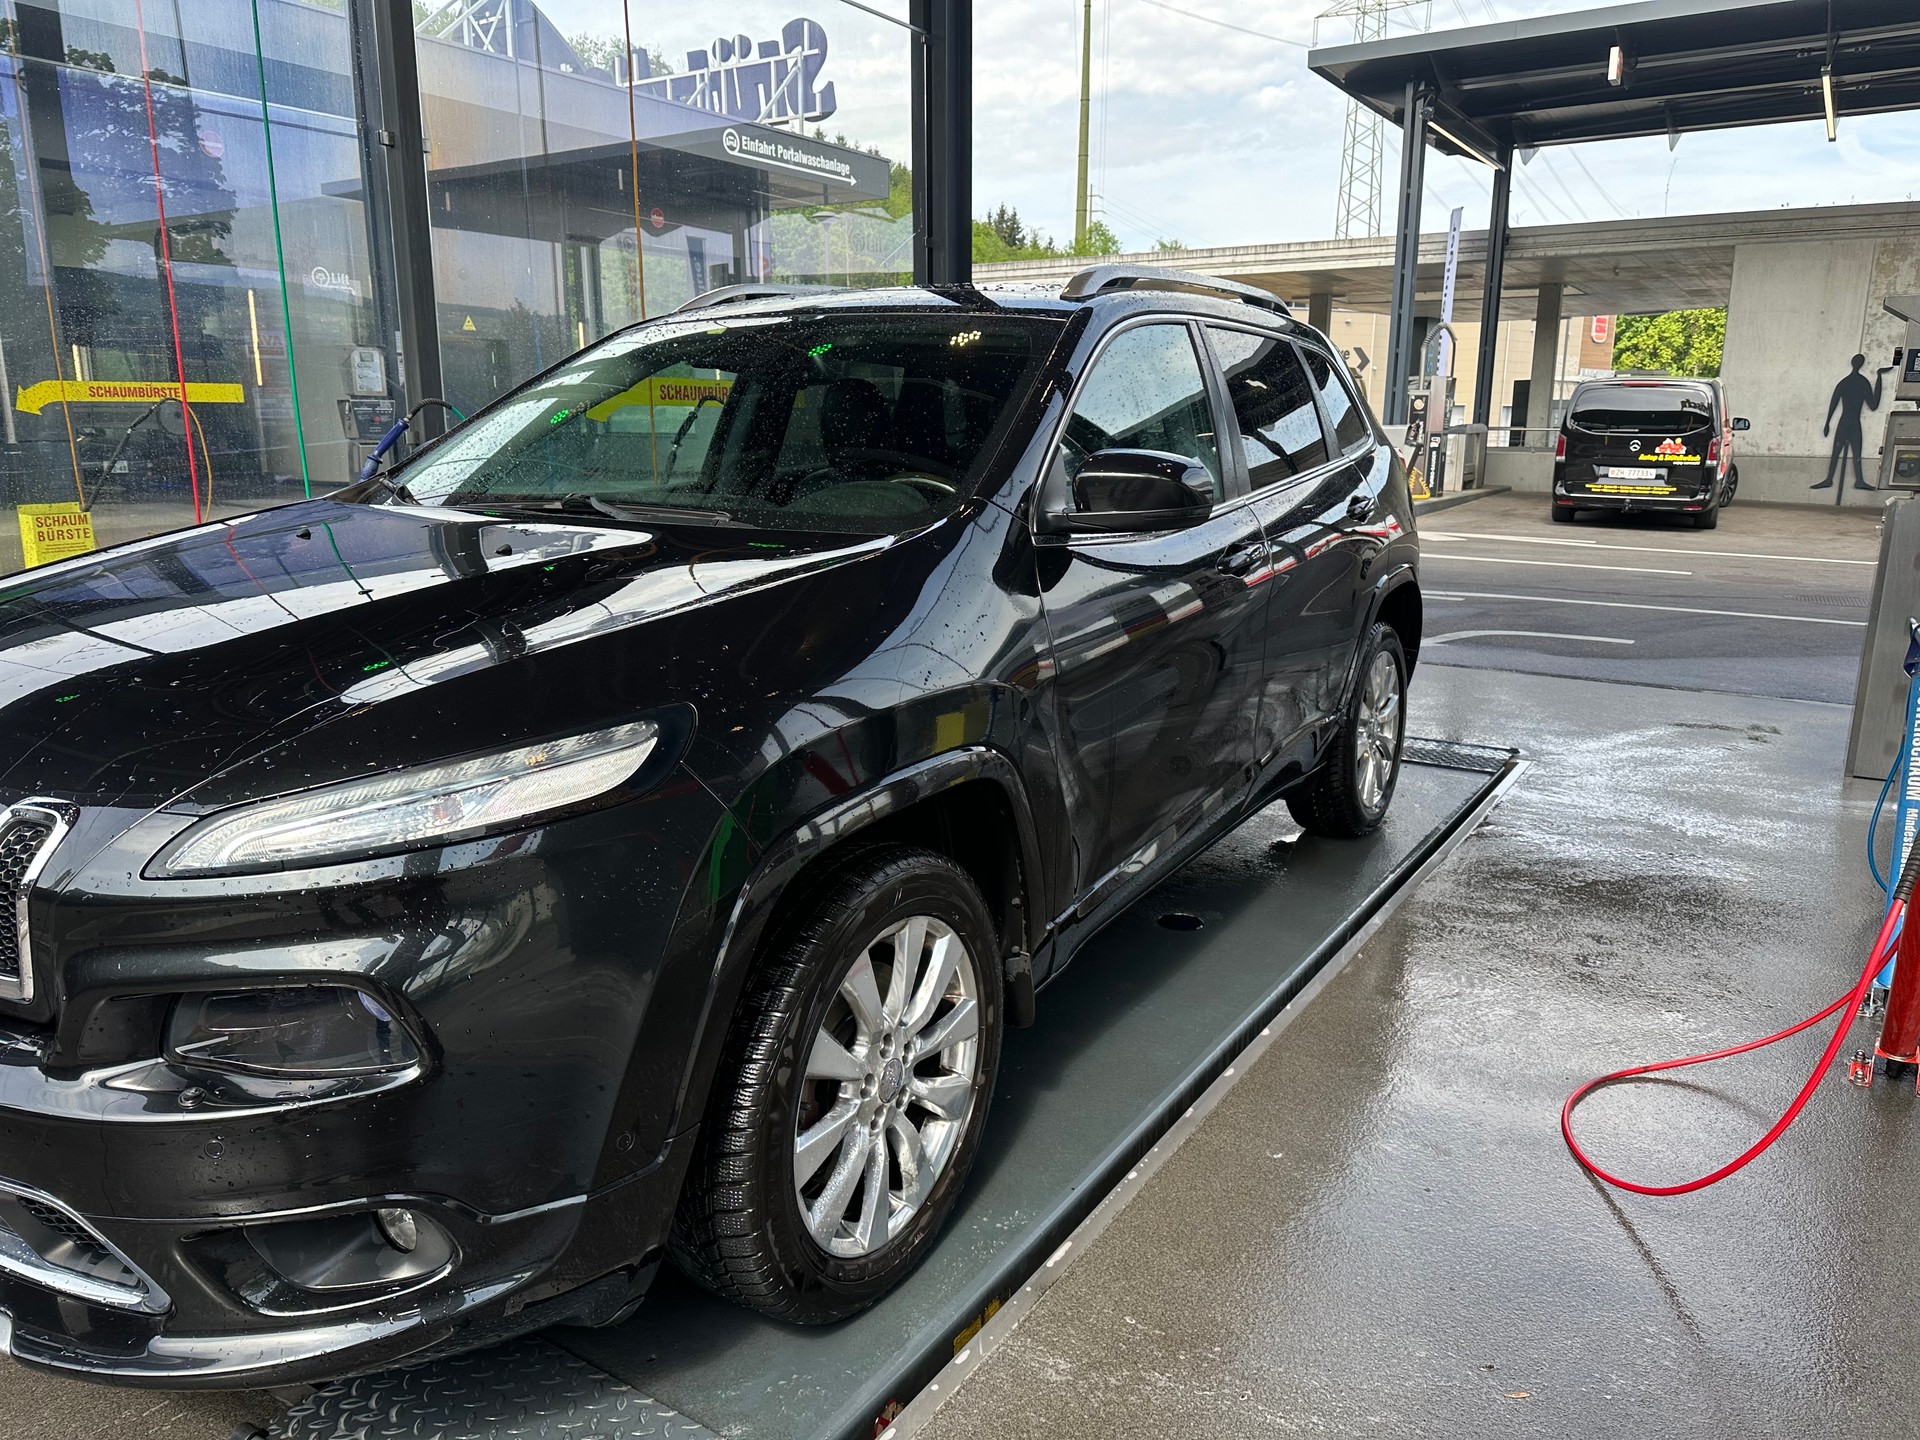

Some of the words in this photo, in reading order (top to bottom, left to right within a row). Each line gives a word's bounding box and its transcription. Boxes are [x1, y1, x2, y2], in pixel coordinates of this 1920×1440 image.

[741, 135, 776, 158] Einfahrt
[777, 144, 850, 176] Portalwaschanlage
[331, 271, 350, 285] Lift
[88, 384, 182, 398] SCHAUMBÜRSTE
[659, 382, 731, 401] SCHAUMBÜR
[35, 513, 89, 528] SCHAUM
[38, 527, 91, 542] BÜRSTE
